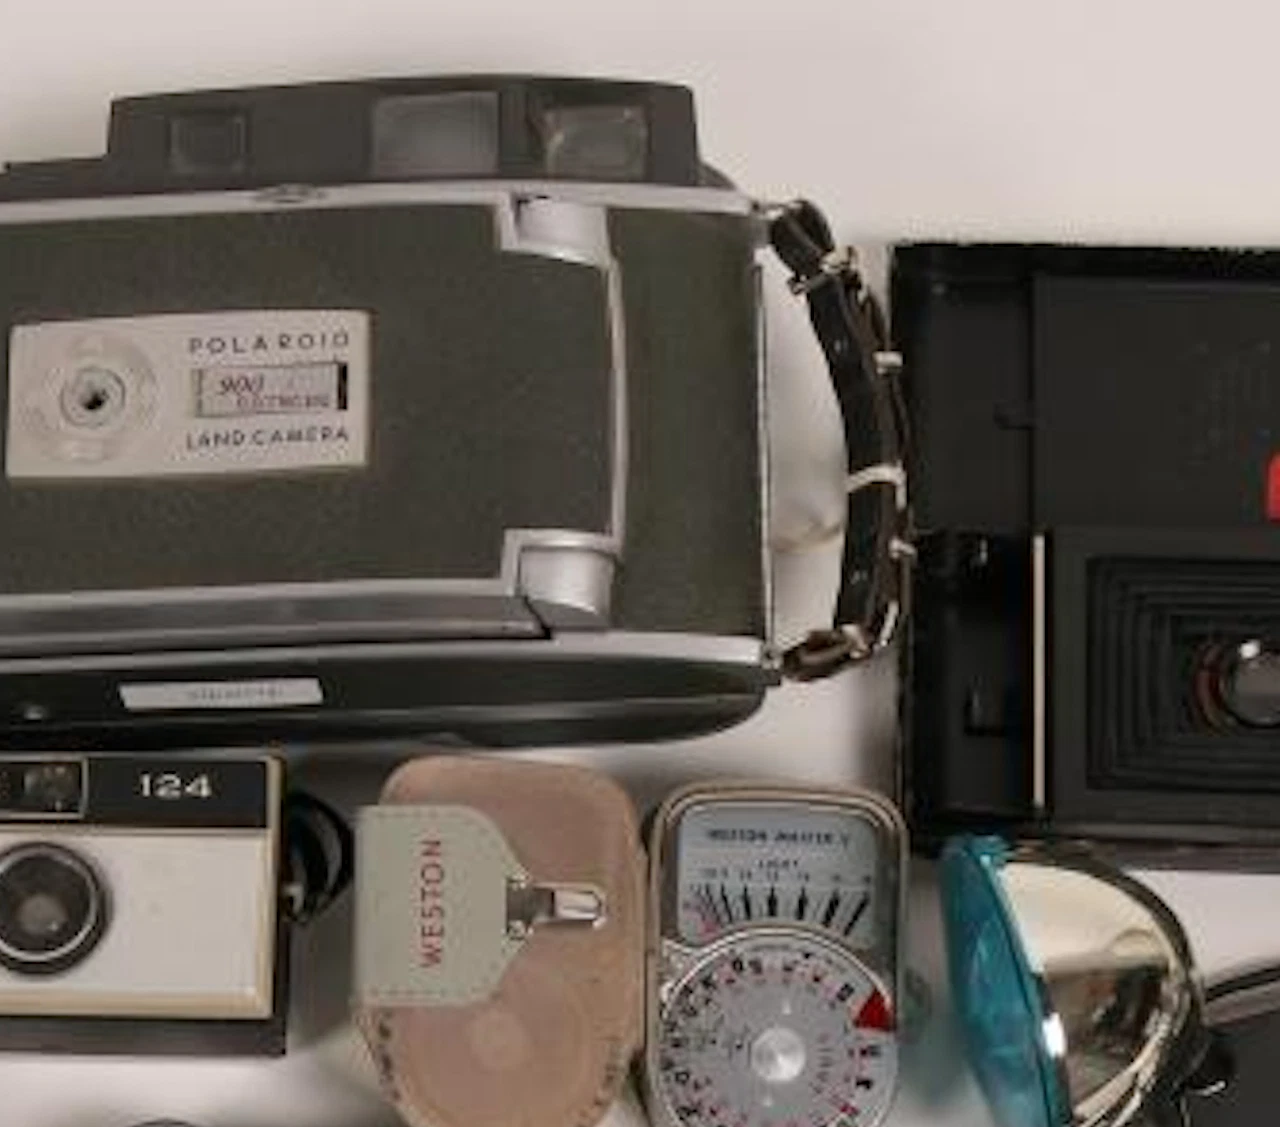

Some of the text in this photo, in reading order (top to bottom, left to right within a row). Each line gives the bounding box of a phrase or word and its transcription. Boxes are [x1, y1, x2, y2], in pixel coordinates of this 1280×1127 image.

[189, 332, 349, 354] POLAROID
[186, 425, 349, 451] LAND CAMERA
[139, 772, 212, 799] 124
[421, 838, 445, 969] WESTON
